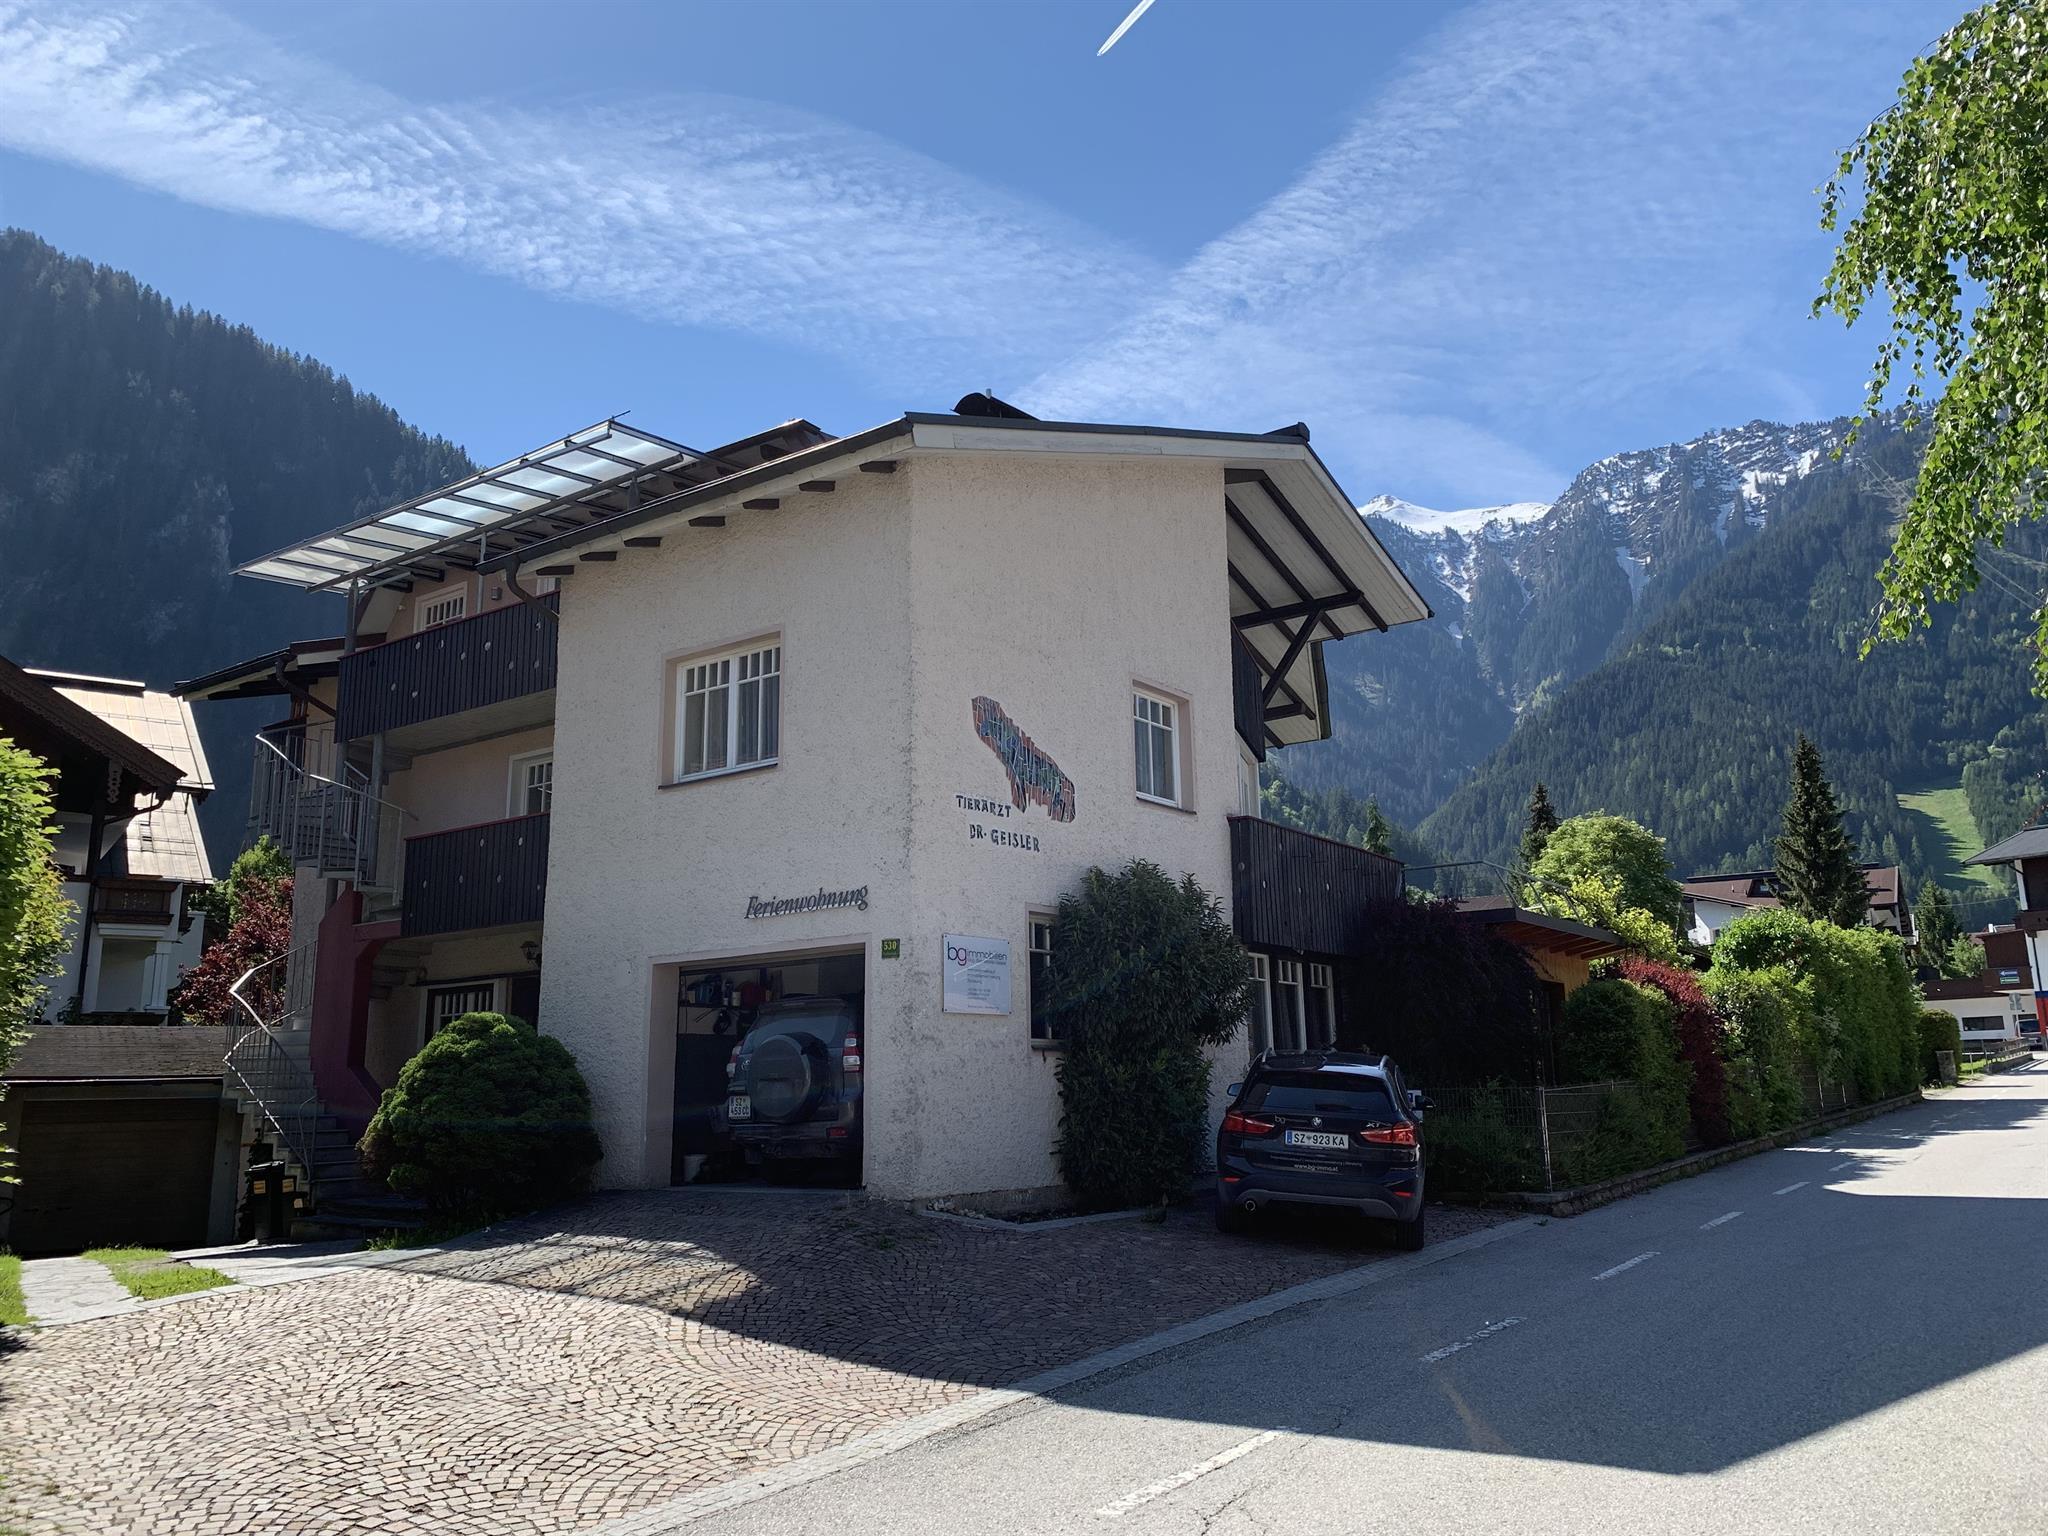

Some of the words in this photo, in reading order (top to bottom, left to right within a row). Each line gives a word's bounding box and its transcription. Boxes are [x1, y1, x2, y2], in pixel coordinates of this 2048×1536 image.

[956, 795, 1011, 818] TIERARZT
[991, 829, 1040, 853] GEISLER
[744, 885, 869, 919] Ferienwohnung
[884, 941, 897, 951] 530
[1293, 1133, 1305, 1144] SZ
